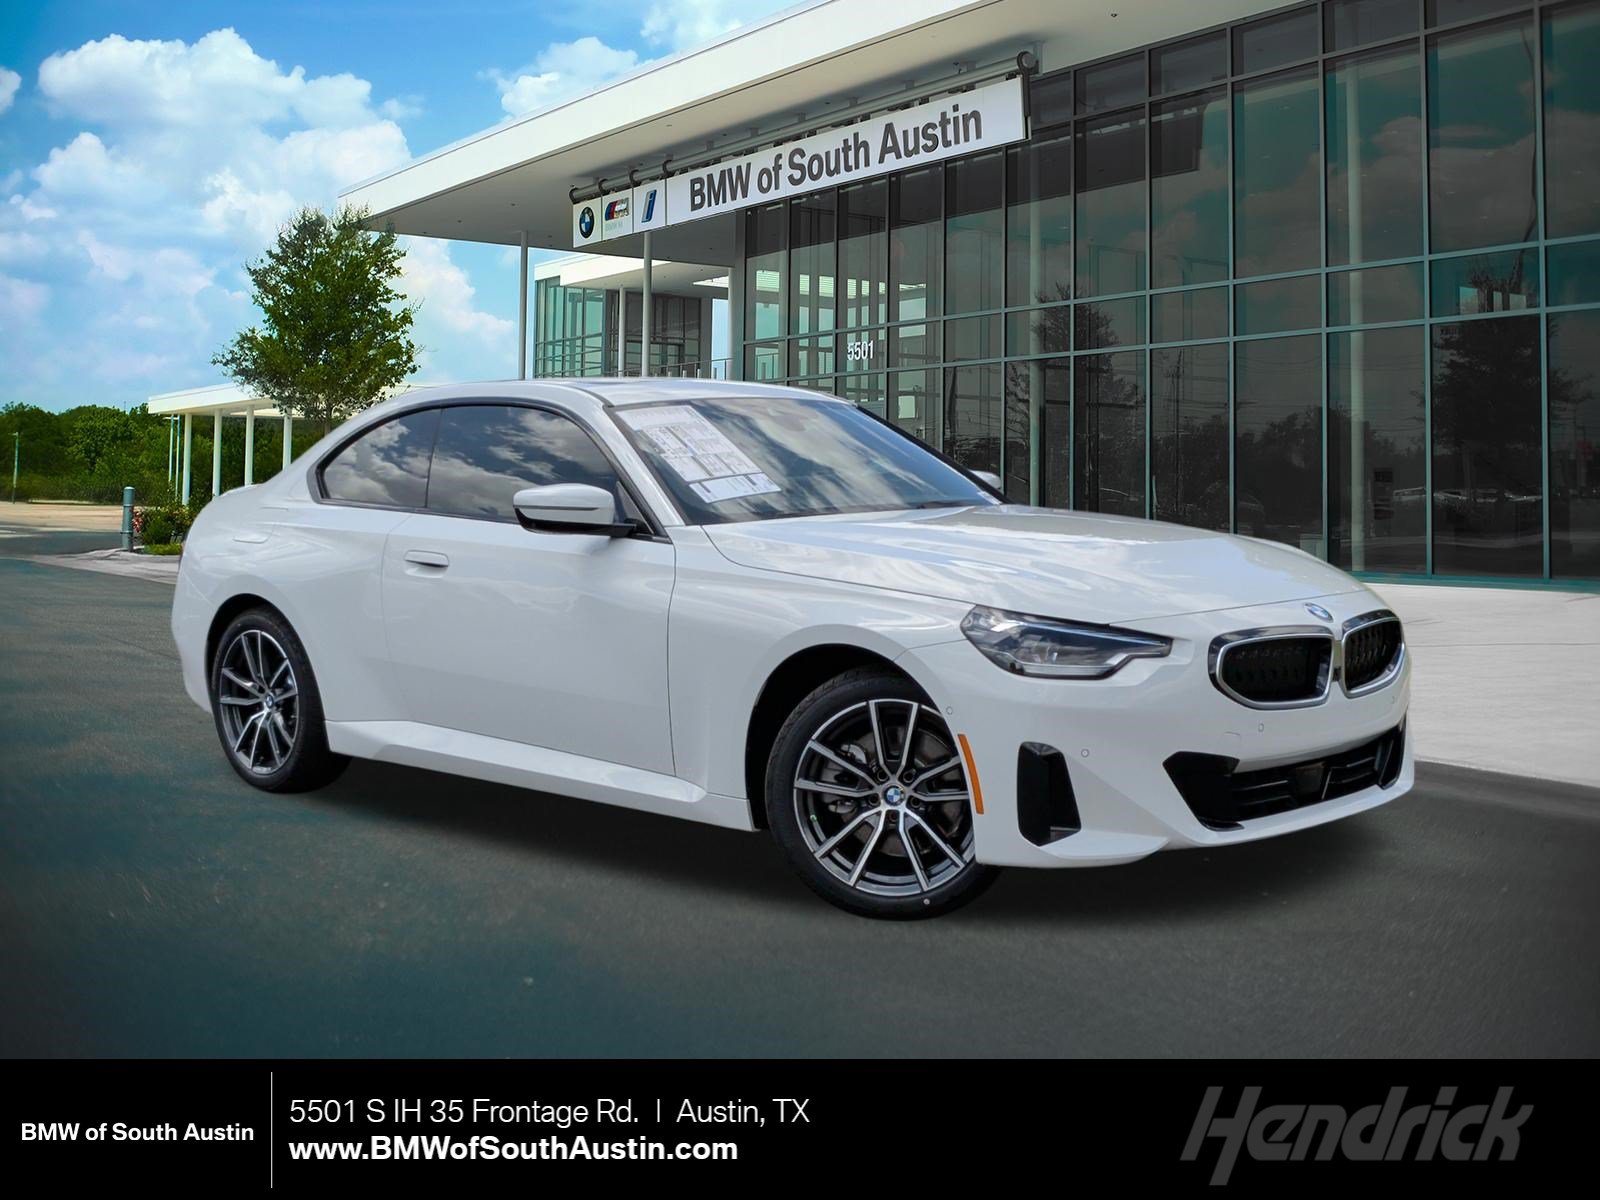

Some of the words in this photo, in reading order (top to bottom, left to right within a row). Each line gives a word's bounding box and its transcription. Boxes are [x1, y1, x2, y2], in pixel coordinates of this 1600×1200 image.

[689, 162, 752, 212] BMW
[757, 152, 783, 194] of
[787, 137, 871, 187] South
[878, 103, 983, 165] Austin
[847, 340, 874, 361] 5501
